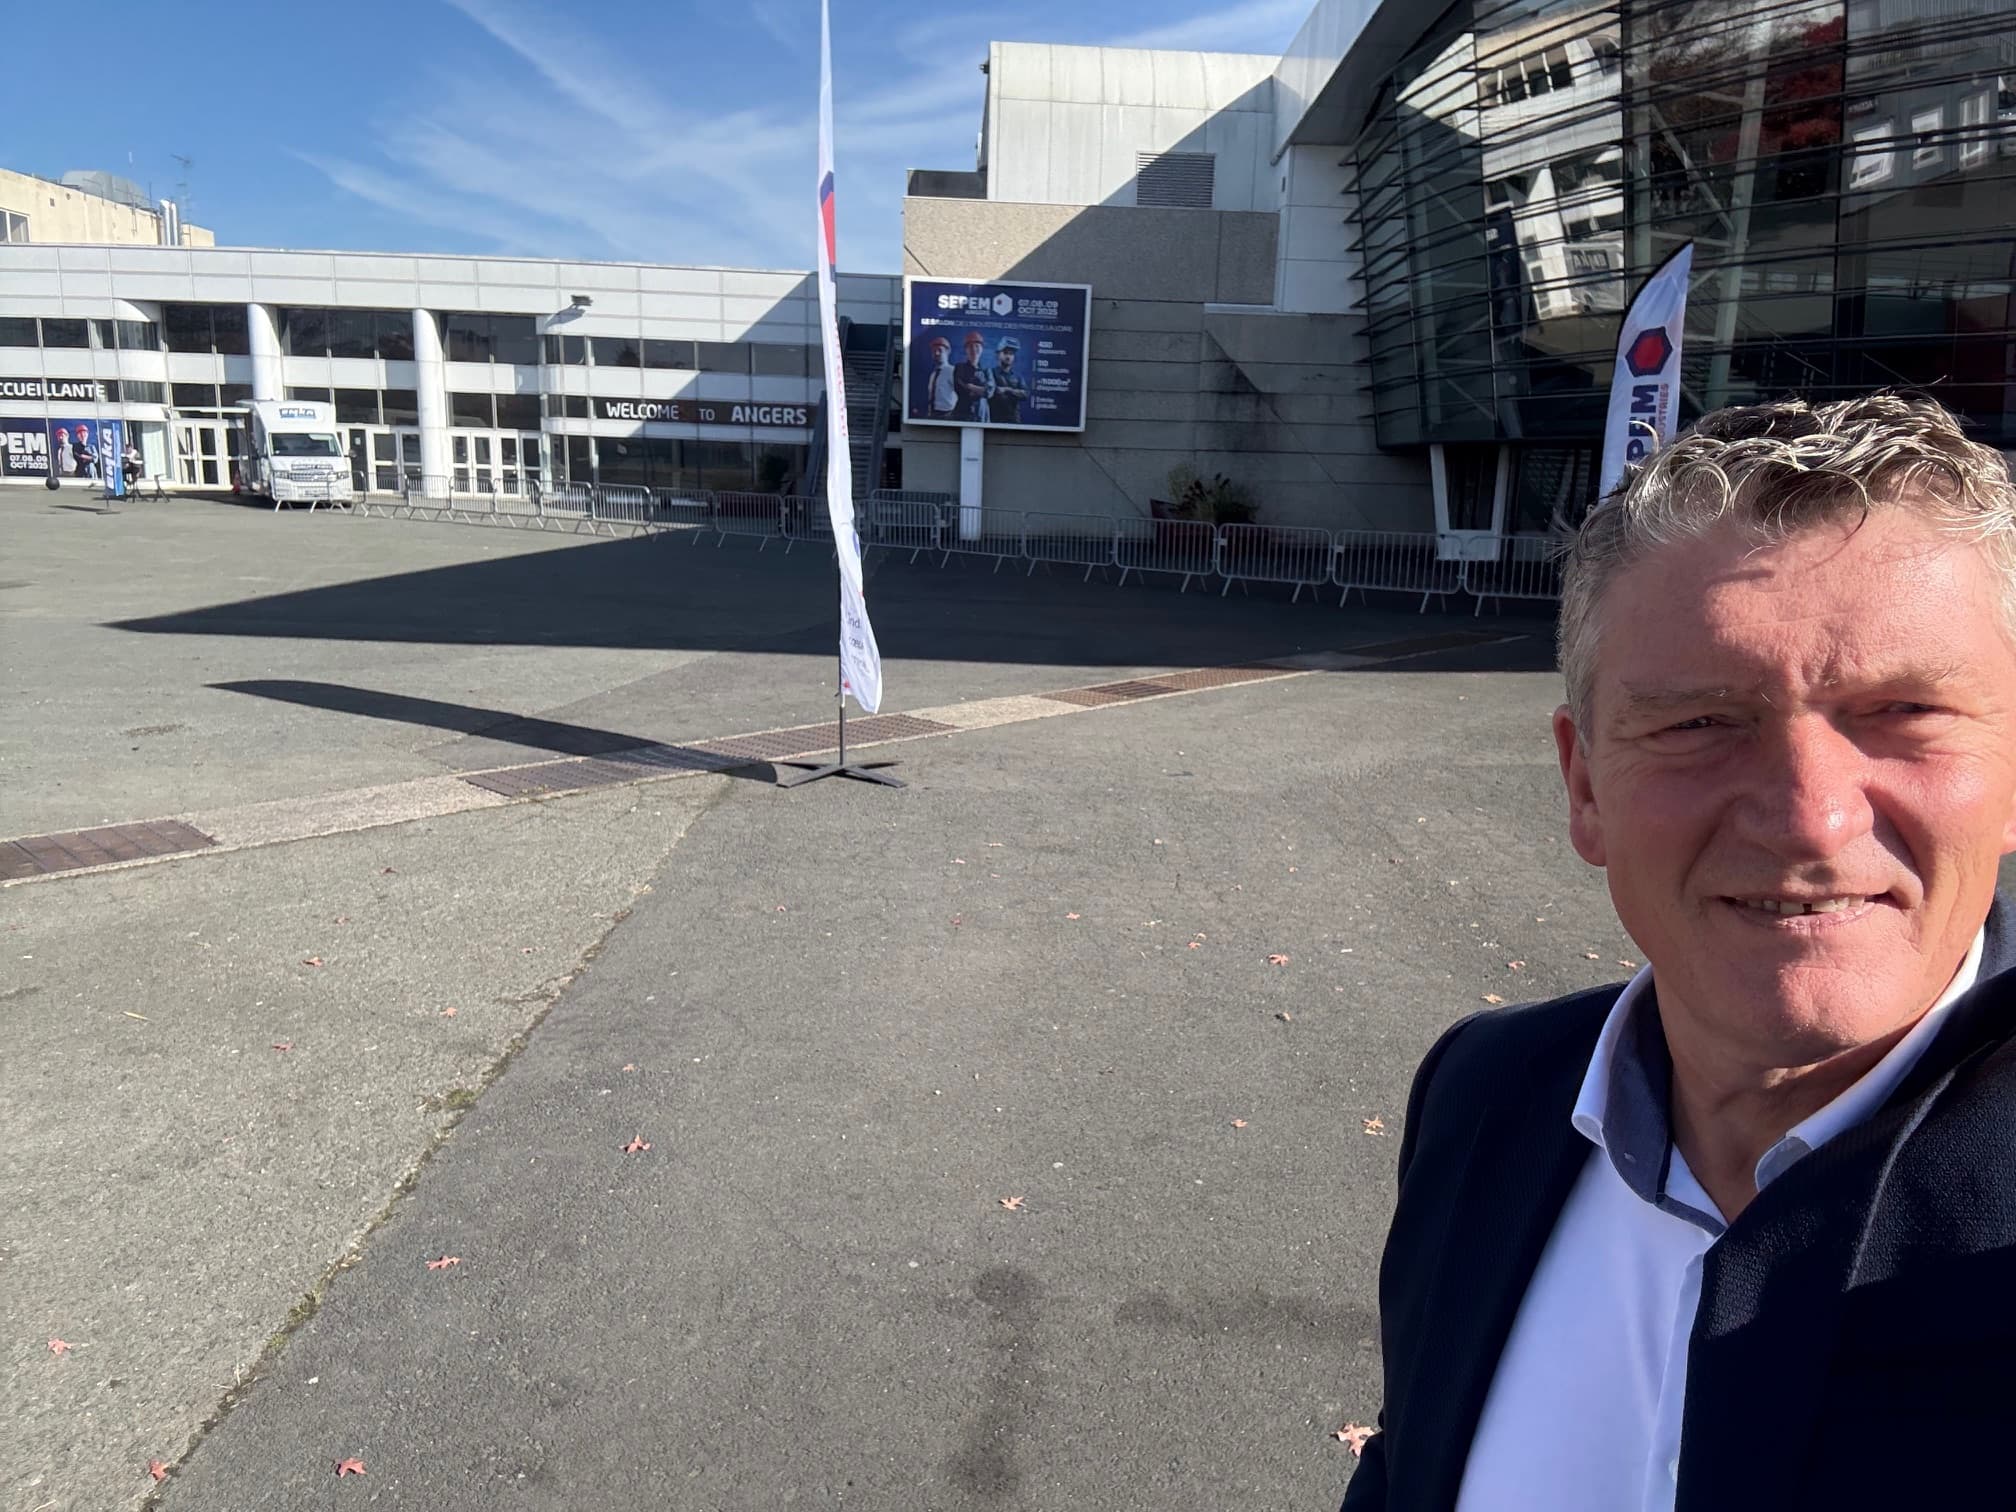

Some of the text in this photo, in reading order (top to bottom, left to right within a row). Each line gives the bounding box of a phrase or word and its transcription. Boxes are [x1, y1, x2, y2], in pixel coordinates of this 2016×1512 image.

[938, 294, 990, 310] SEPEM
[606, 402, 807, 424] WELCOME TO ANGERS
[1626, 384, 1659, 460] PEM
